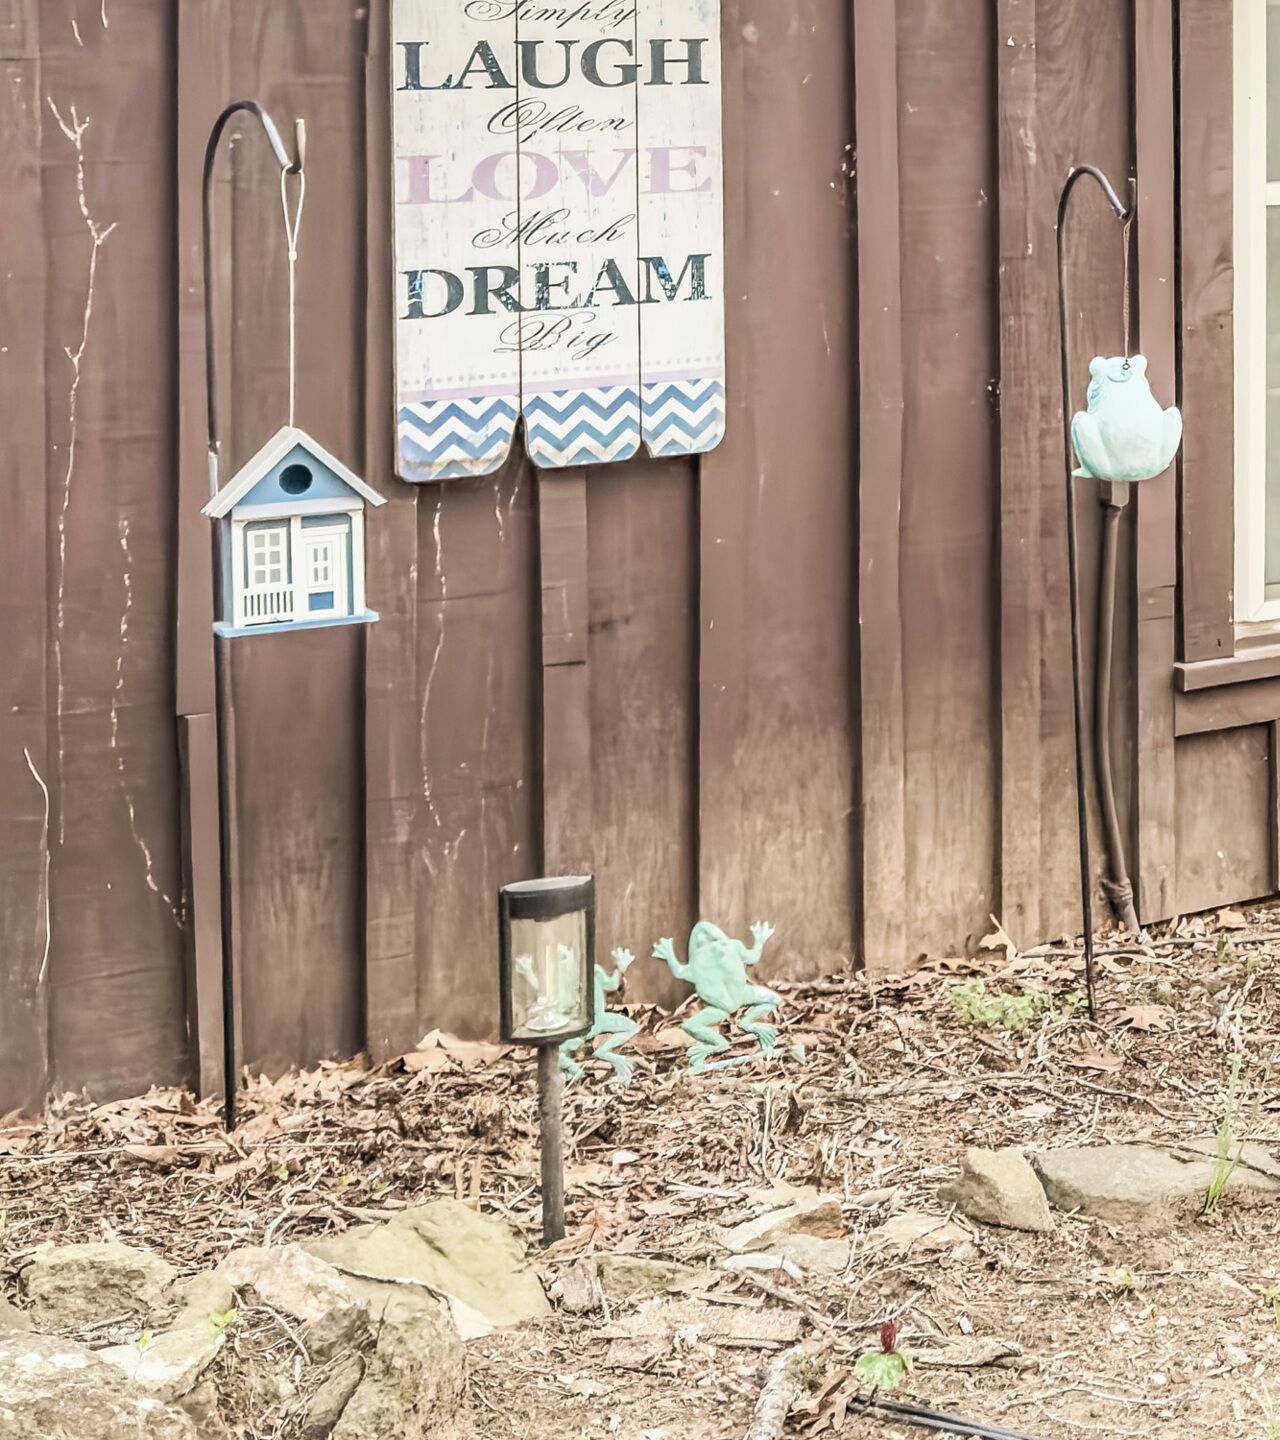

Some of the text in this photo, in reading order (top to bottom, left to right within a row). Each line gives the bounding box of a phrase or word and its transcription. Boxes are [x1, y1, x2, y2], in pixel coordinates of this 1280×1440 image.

[397, 38, 710, 91] LAUGH
[487, 97, 634, 144] Often
[399, 146, 712, 206] LOVE
[472, 208, 636, 250] Much
[400, 253, 713, 321] DREAM
[492, 311, 619, 361] Big
